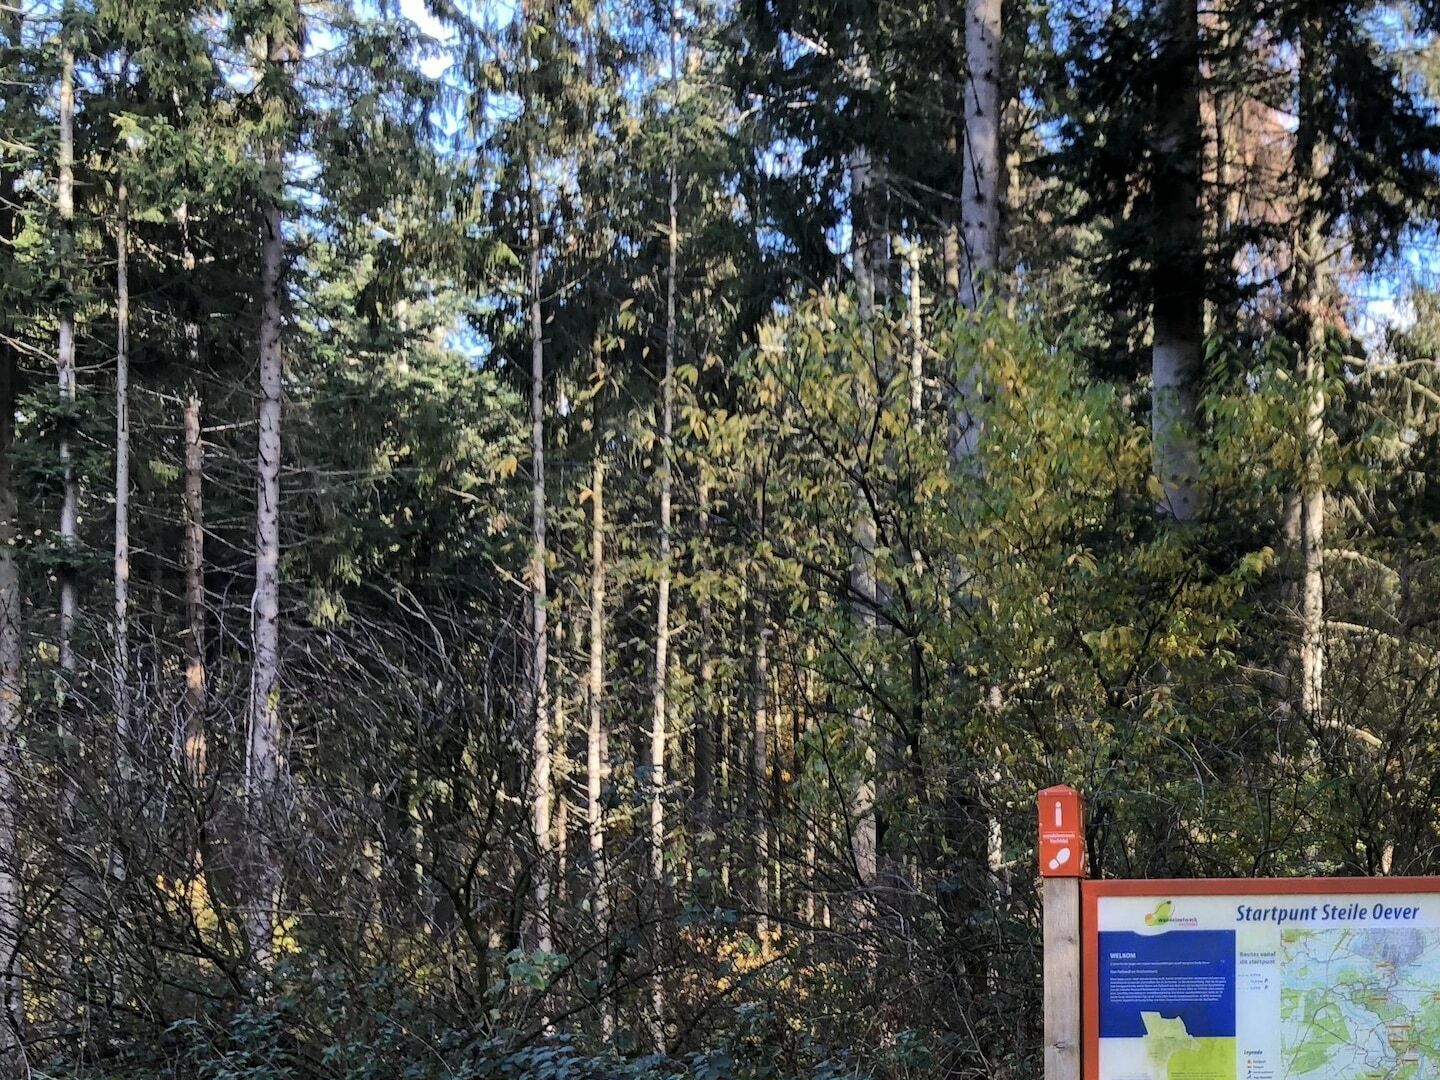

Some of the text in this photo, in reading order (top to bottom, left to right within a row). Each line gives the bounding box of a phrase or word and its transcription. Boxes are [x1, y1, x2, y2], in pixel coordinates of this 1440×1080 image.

[1236, 903, 1420, 925] Startpunt Steile Oever
